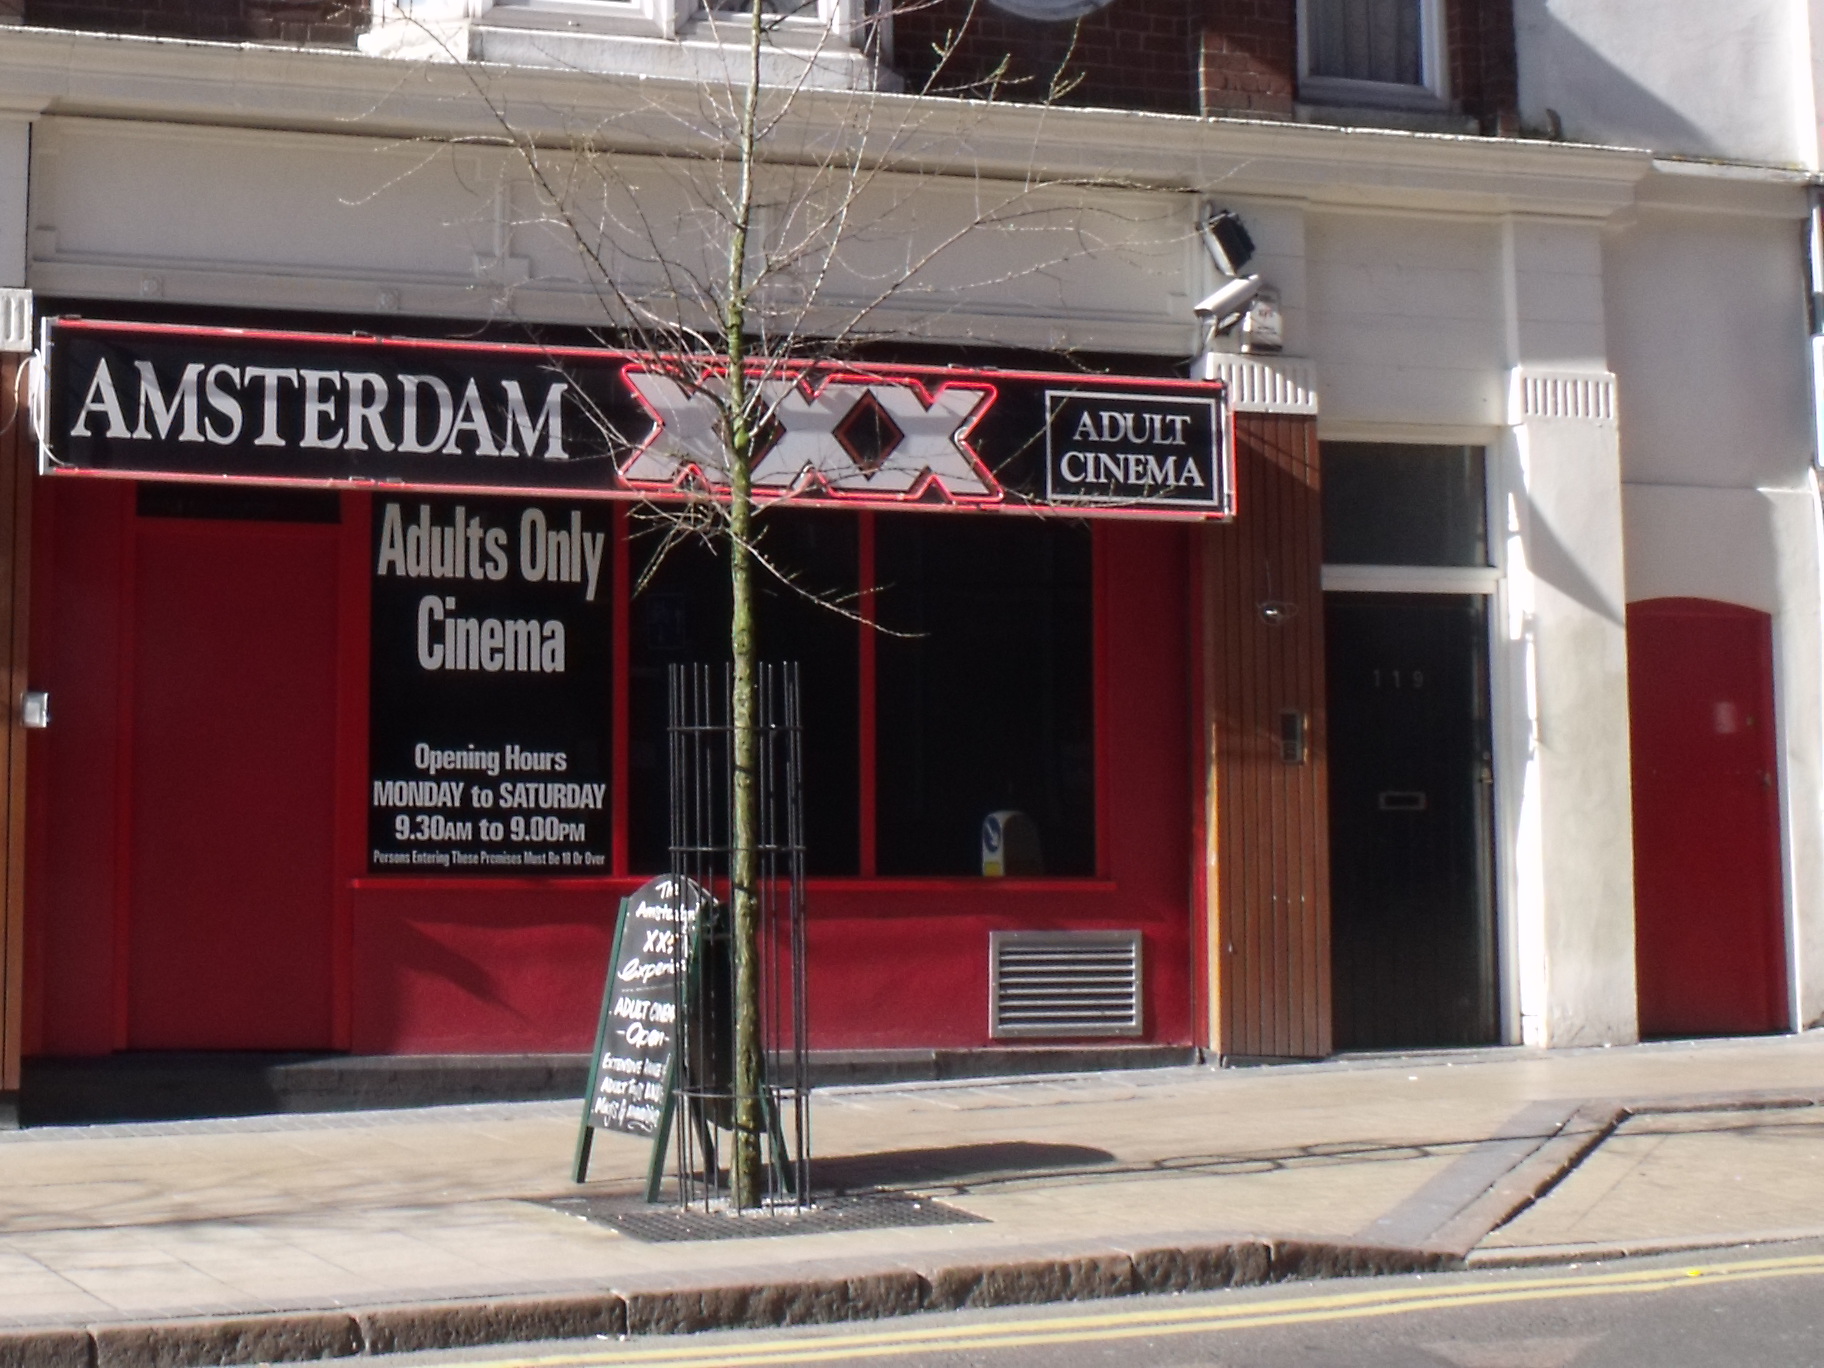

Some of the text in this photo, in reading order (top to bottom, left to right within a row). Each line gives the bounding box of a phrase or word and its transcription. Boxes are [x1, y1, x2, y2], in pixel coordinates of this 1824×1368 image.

[70, 356, 1004, 503] AMSTERDAM XXX
[1072, 409, 1191, 445] ADULT
[1059, 451, 1205, 488] CINEMA
[378, 501, 605, 602] Adults Only
[417, 594, 566, 674] Cinema
[1372, 669, 1425, 688] 119
[414, 743, 567, 776] Opening Hours
[373, 781, 606, 810] MONDAY to SATURDAY
[395, 814, 586, 842] 9.30AM to 9.00PM
[373, 849, 410, 864] Persons
[412, 850, 450, 867] Entering
[614, 997, 651, 1020] ADULT
